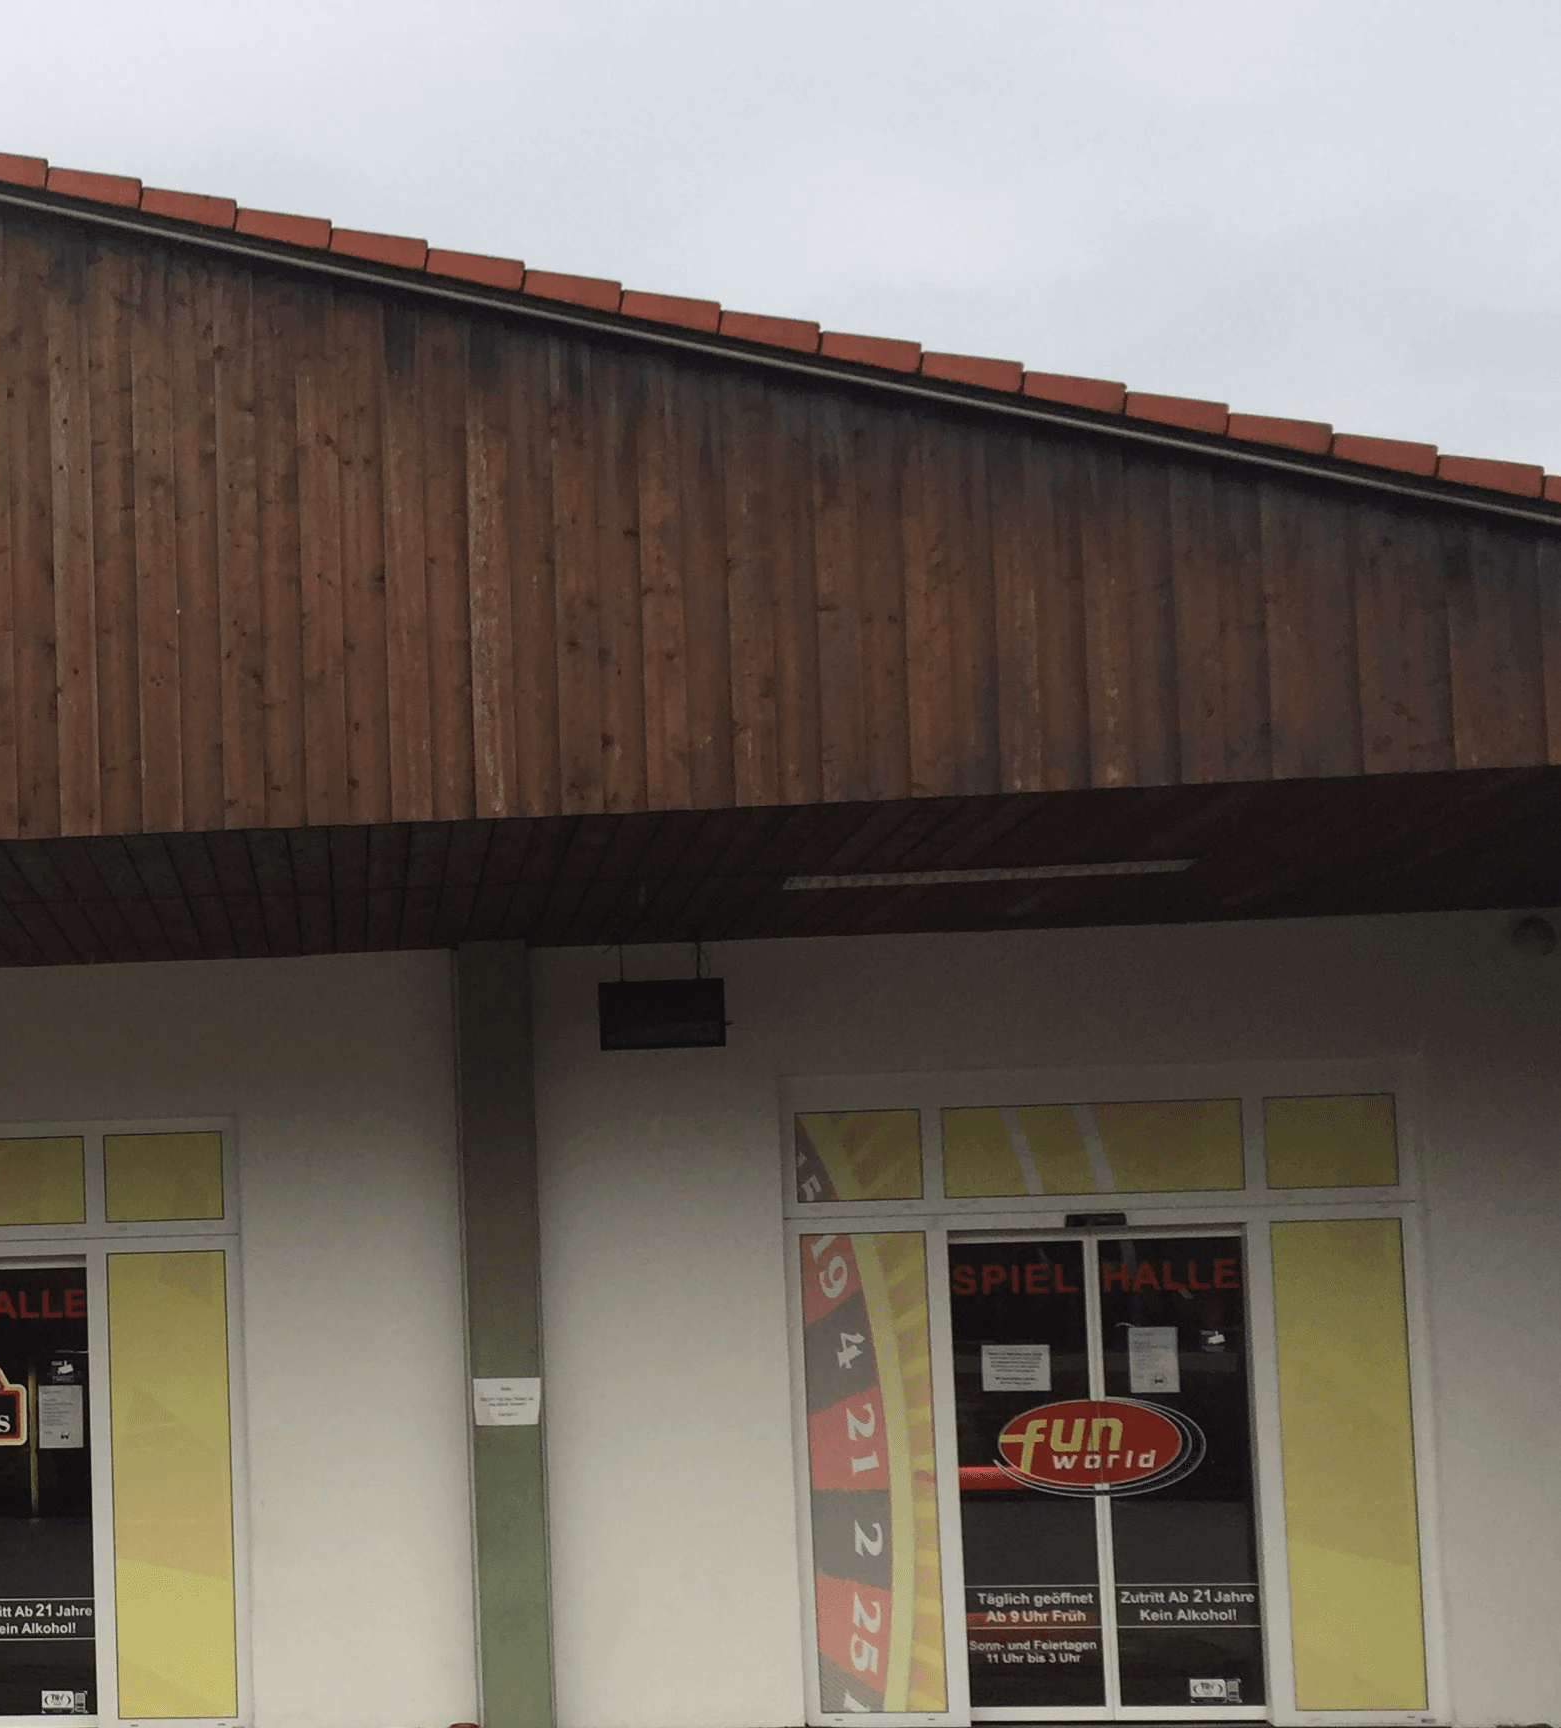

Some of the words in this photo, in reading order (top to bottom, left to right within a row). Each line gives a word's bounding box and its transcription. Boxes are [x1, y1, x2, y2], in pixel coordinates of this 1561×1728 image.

[951, 1263, 1079, 1295] SPIEL
[1102, 1258, 1239, 1293] HALLE
[837, 1332, 866, 1370] 4
[845, 1402, 880, 1478] 21
[999, 1417, 1124, 1473] fun
[1052, 1449, 1157, 1470] world
[854, 1519, 884, 1557] 2
[977, 1592, 1030, 1608] Täglich
[1033, 1591, 1094, 1608] geöffnet
[1120, 1591, 1165, 1604] Zutritt
[1168, 1591, 1189, 1603] Ab
[1193, 1588, 1211, 1603] 21
[1214, 1591, 1255, 1604] Jahre
[14, 1605, 34, 1618] Ab
[35, 1603, 53, 1617] 21
[55, 1604, 93, 1617] Jahre
[986, 1610, 1007, 1622] Ab
[1010, 1610, 1020, 1622] 9
[1022, 1610, 1049, 1622] Uhr
[1052, 1609, 1087, 1622] Früh
[1140, 1609, 1173, 1621] Kein
[1177, 1608, 1237, 1621] Alkohol!
[21, 1622, 77, 1634] Alkohol!
[849, 1591, 882, 1676] 25
[969, 1641, 1005, 1651] Sonn-
[1007, 1640, 1031, 1651] und
[1033, 1640, 1098, 1652] Feiertagen
[987, 1653, 999, 1664] 11
[1002, 1653, 1025, 1664] Uhr
[1027, 1652, 1046, 1663] bis
[1048, 1652, 1057, 1663] 3
[1059, 1652, 1081, 1663] Uhr
